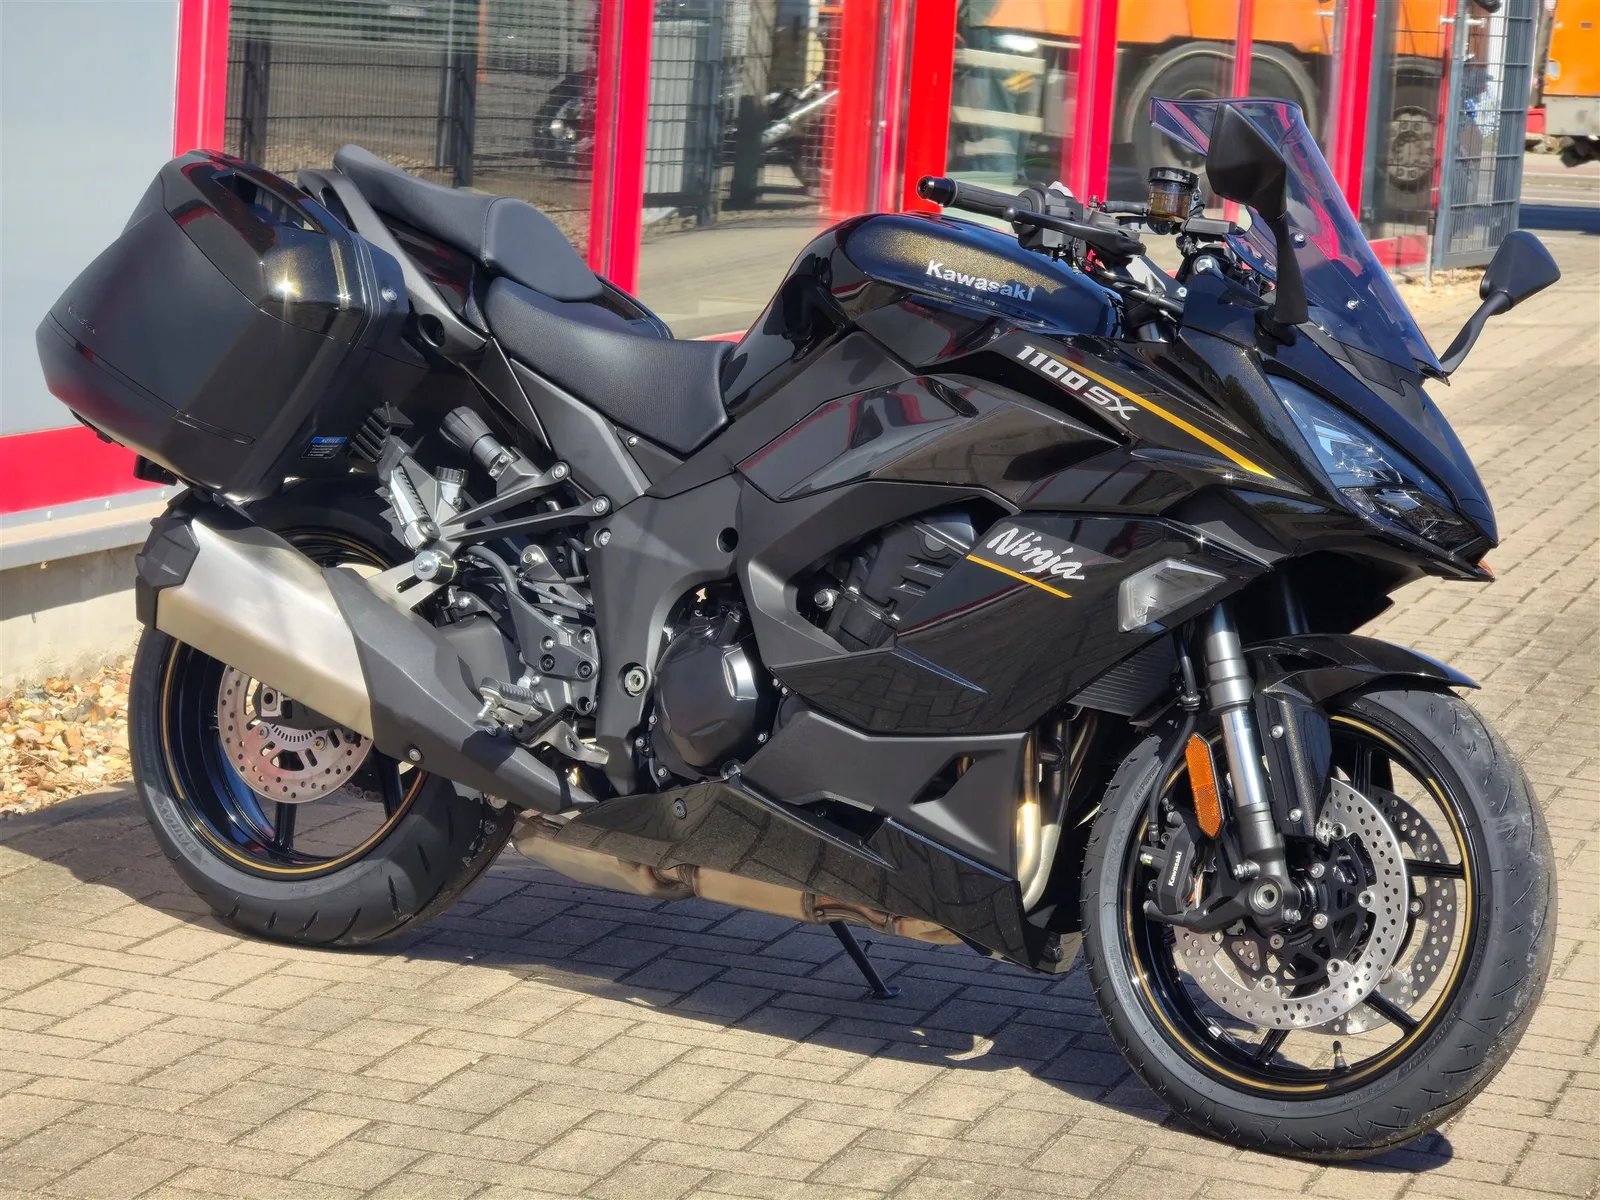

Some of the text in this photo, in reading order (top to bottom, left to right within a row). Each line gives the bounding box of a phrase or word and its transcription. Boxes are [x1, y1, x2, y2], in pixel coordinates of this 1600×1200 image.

[926, 260, 1035, 301] Kawasaki
[986, 527, 1085, 580] Ninja
[1168, 851, 1182, 887] Kawasaki
